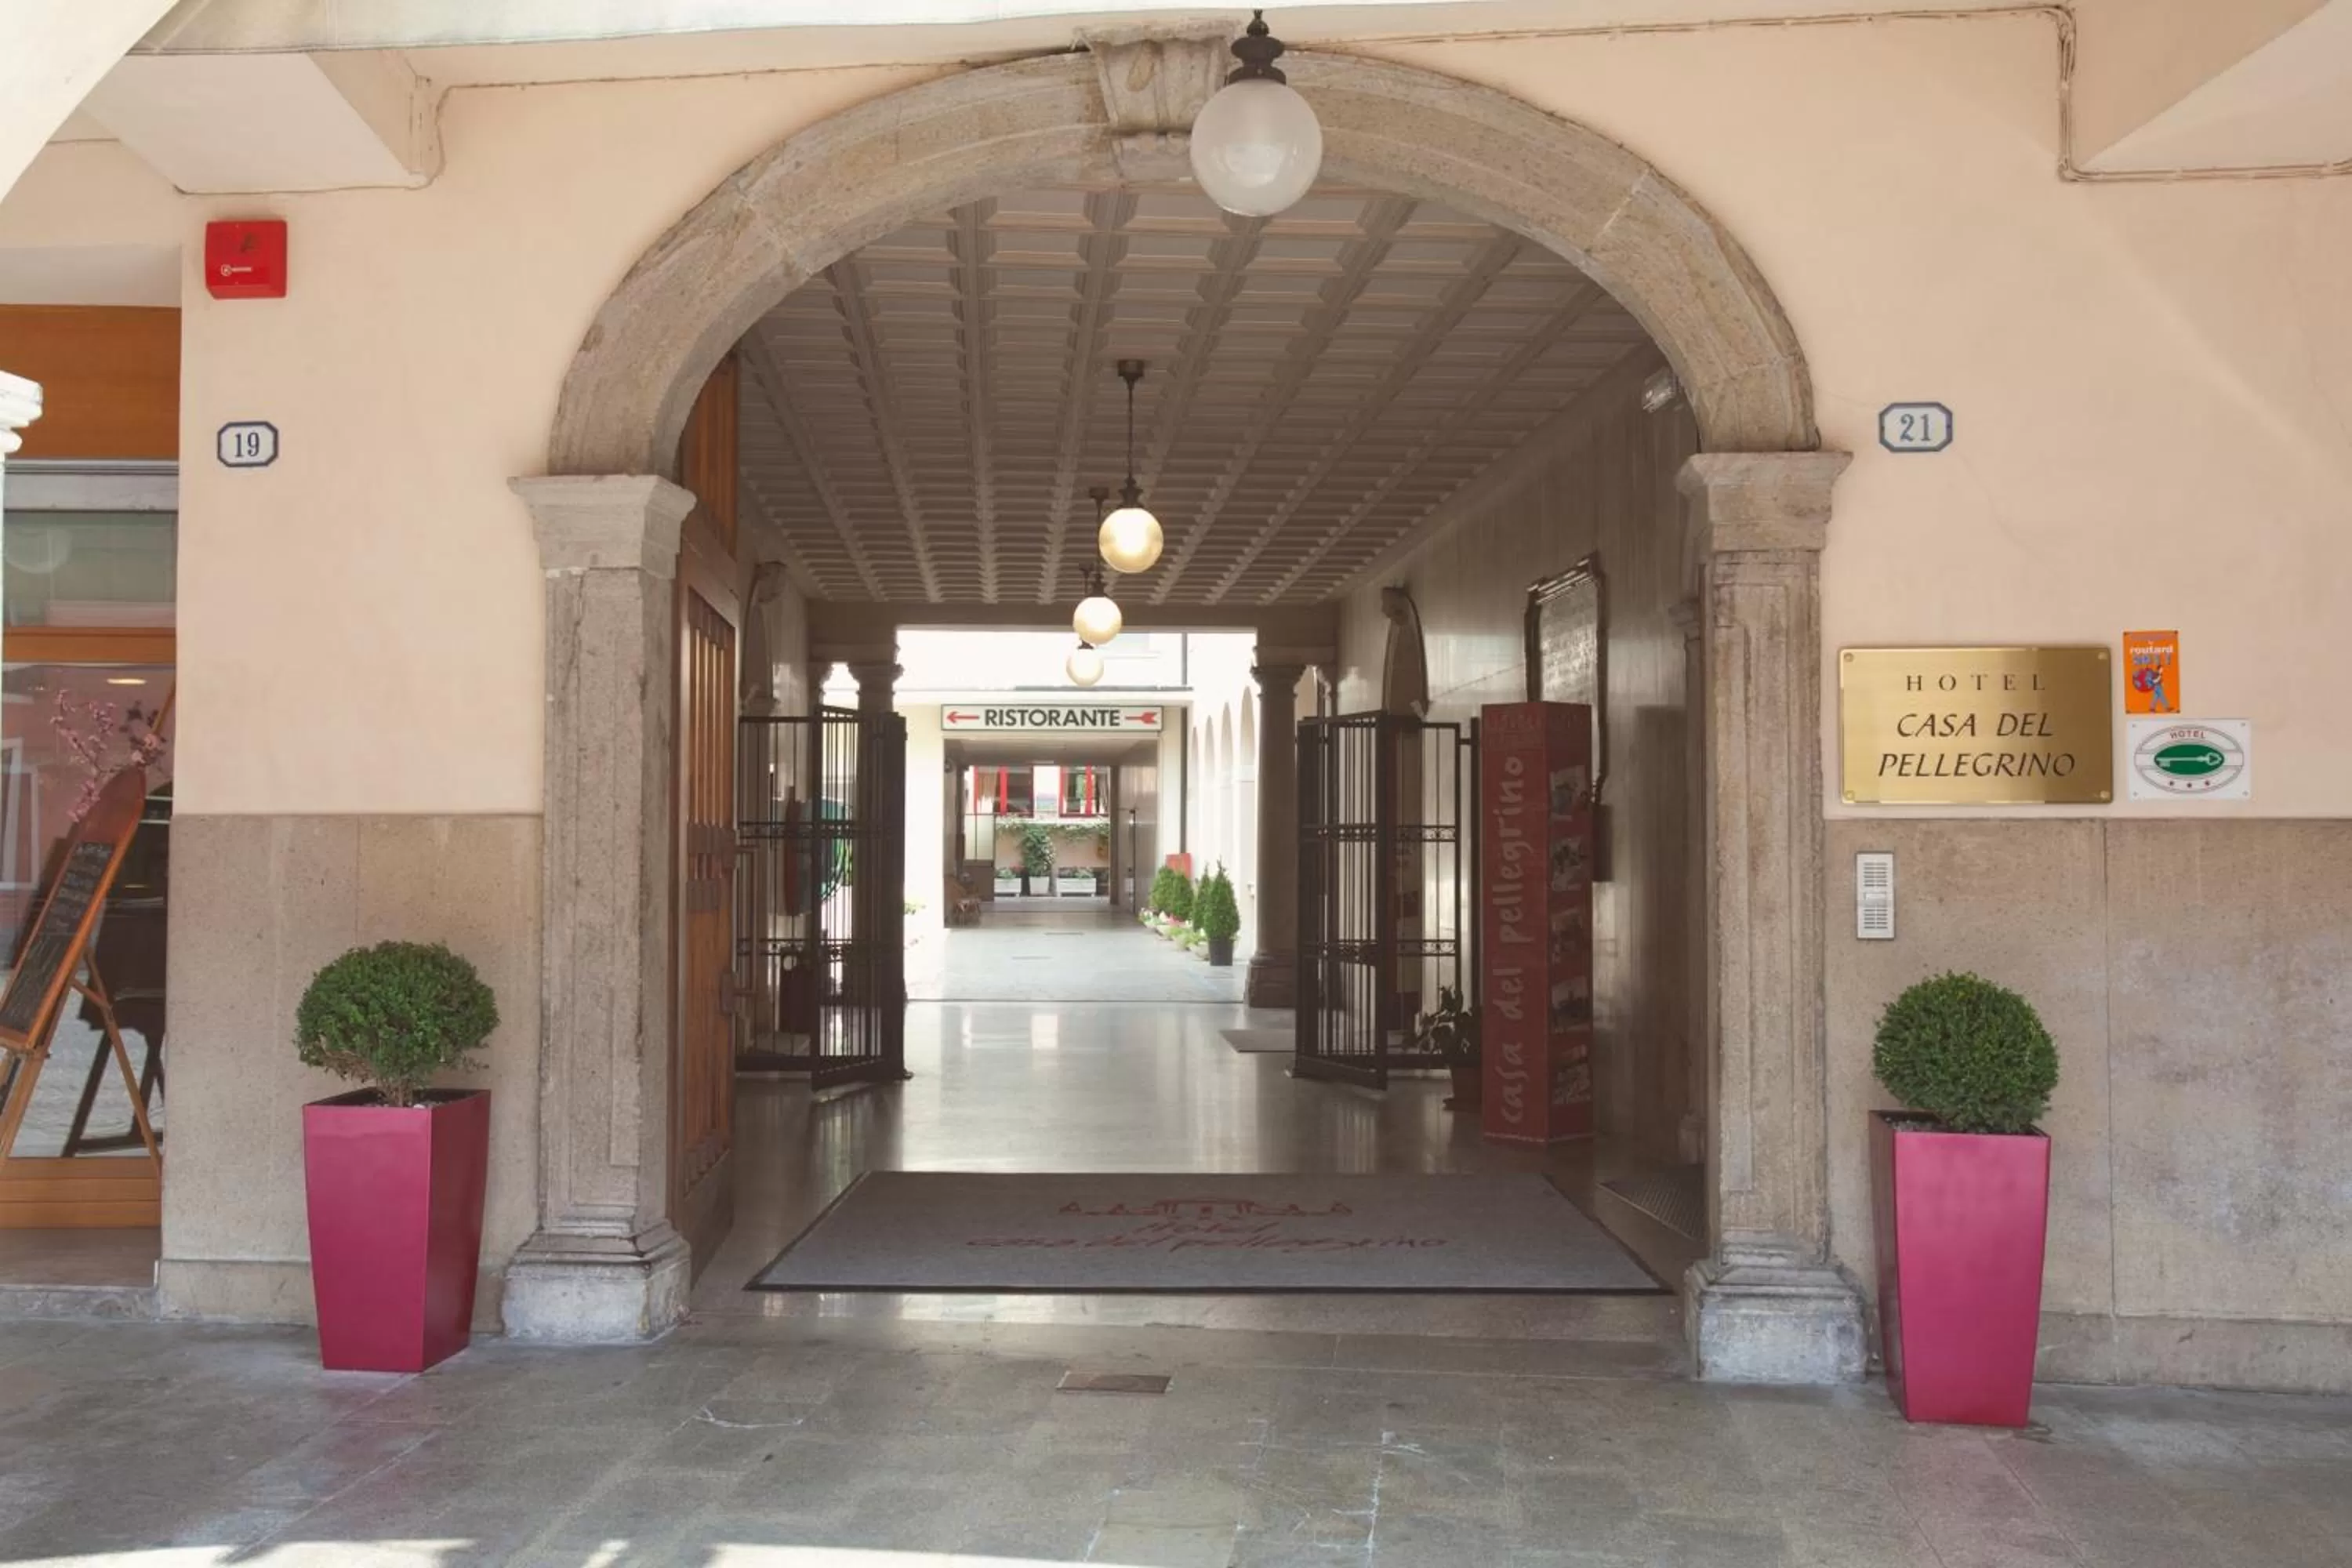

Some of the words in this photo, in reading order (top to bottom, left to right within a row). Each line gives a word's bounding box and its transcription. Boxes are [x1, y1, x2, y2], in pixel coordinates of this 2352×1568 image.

[1900, 414, 1931, 441] 21
[235, 432, 260, 457] 19
[2129, 644, 2173, 654] routard
[1906, 673, 2045, 691] HOTEL
[985, 709, 1120, 726] RISTORANTE
[1896, 712, 1976, 738] CASA
[1996, 712, 2054, 737] DEL
[2169, 730, 2206, 739] HOTEL
[1878, 752, 2076, 777] PELLEGRINO
[1491, 756, 1534, 943] pellegrino
[1492, 967, 1524, 1020] del
[1494, 1041, 1530, 1124] casa
